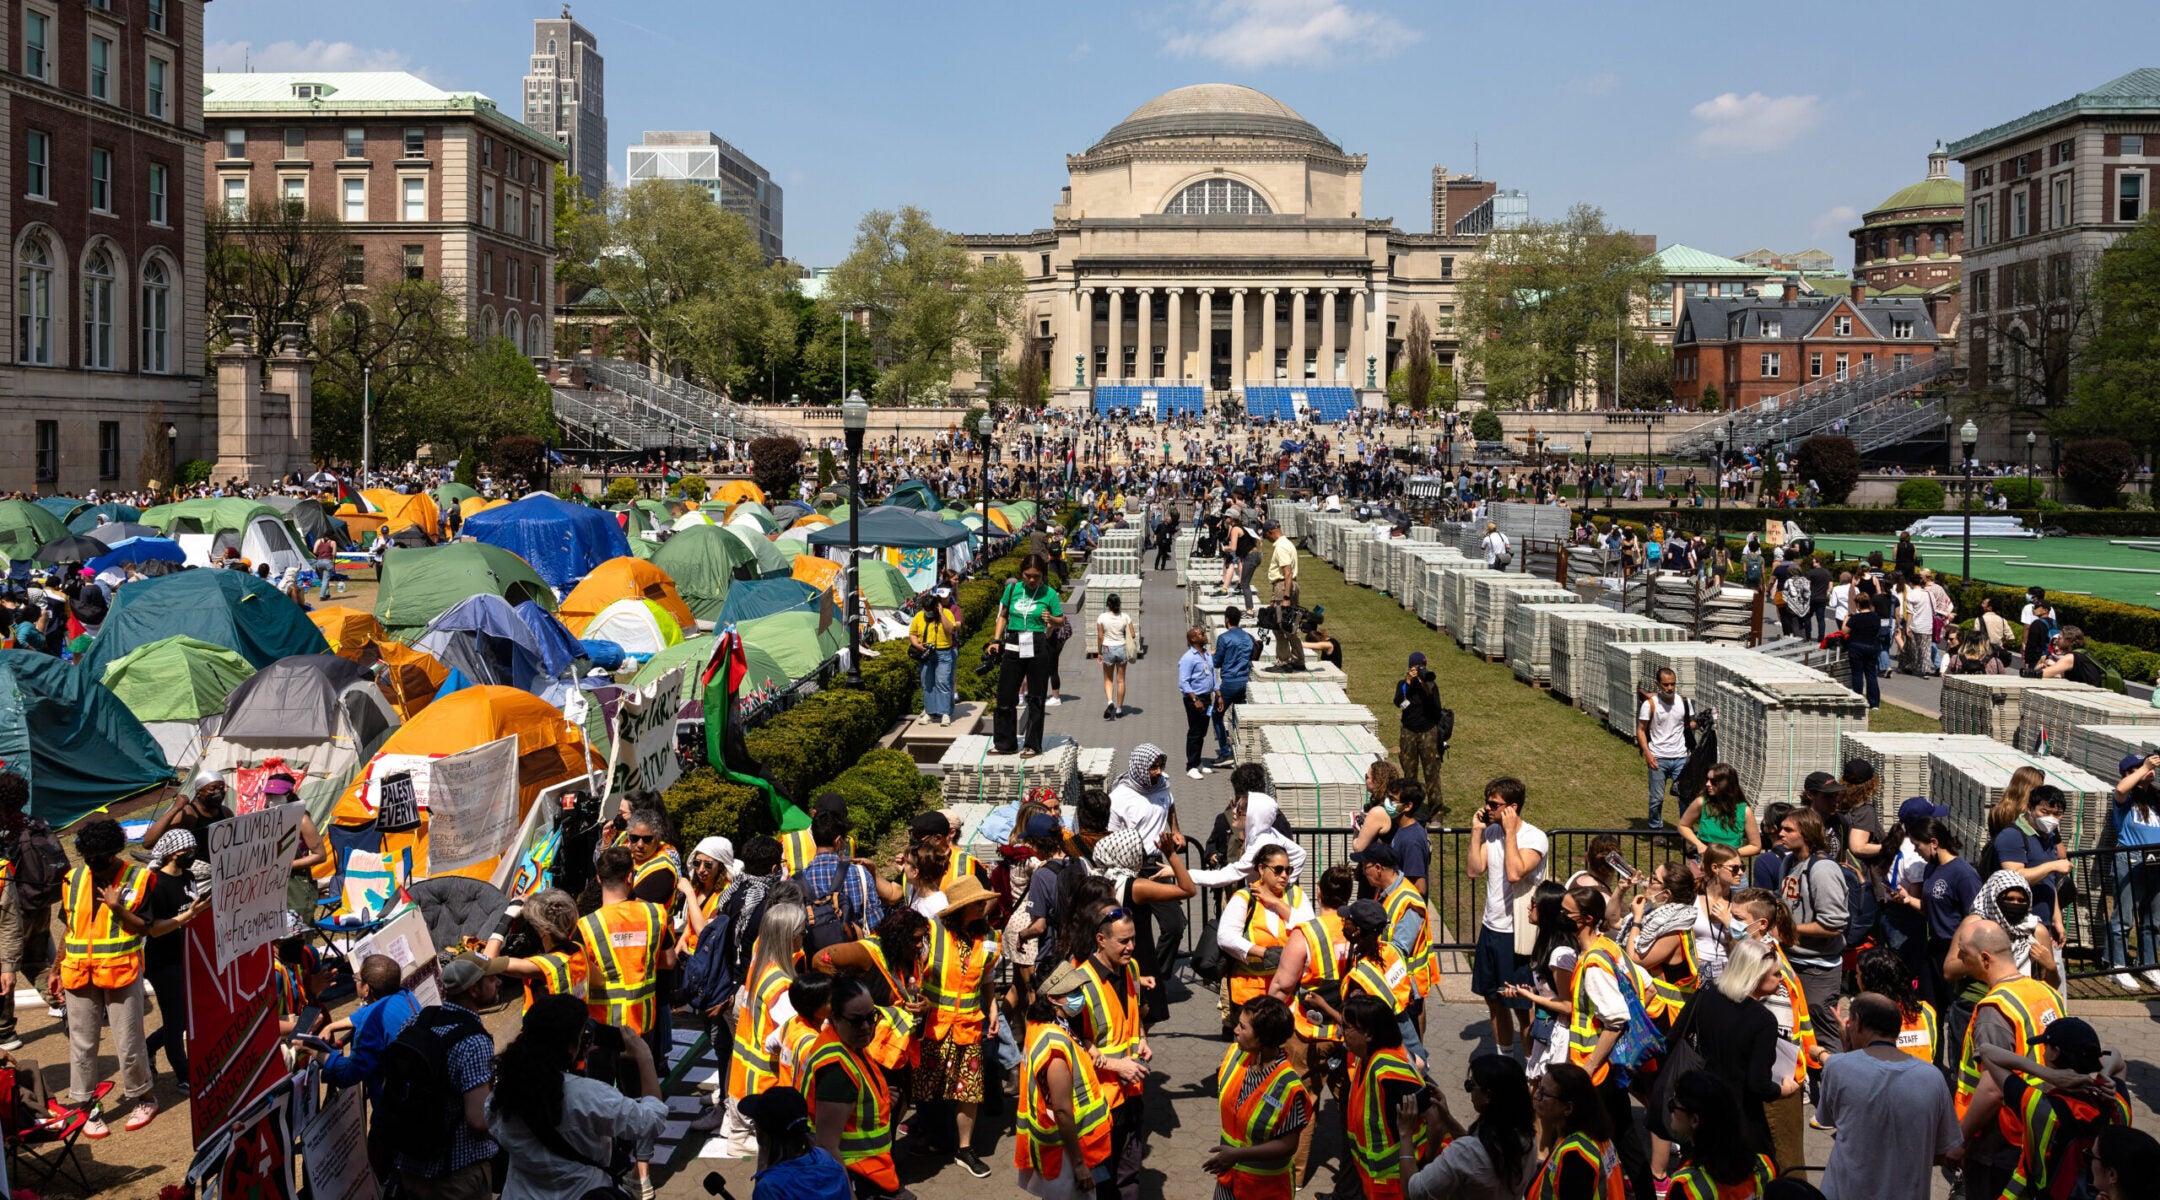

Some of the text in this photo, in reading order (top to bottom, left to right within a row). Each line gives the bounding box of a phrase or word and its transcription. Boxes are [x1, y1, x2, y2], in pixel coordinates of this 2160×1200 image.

[381, 779, 415, 807] PALESTI
[210, 809, 284, 855] COLUMBIA
[378, 801, 420, 827] EVERYW
[214, 841, 276, 882] ALUMNI
[216, 870, 269, 914] UPPORT
[193, 975, 274, 1089] JUSTIFICATION
[1898, 1034, 1919, 1045] STAFF
[195, 1067, 223, 1108] FOR
[197, 1046, 260, 1132] GENOCIDE
